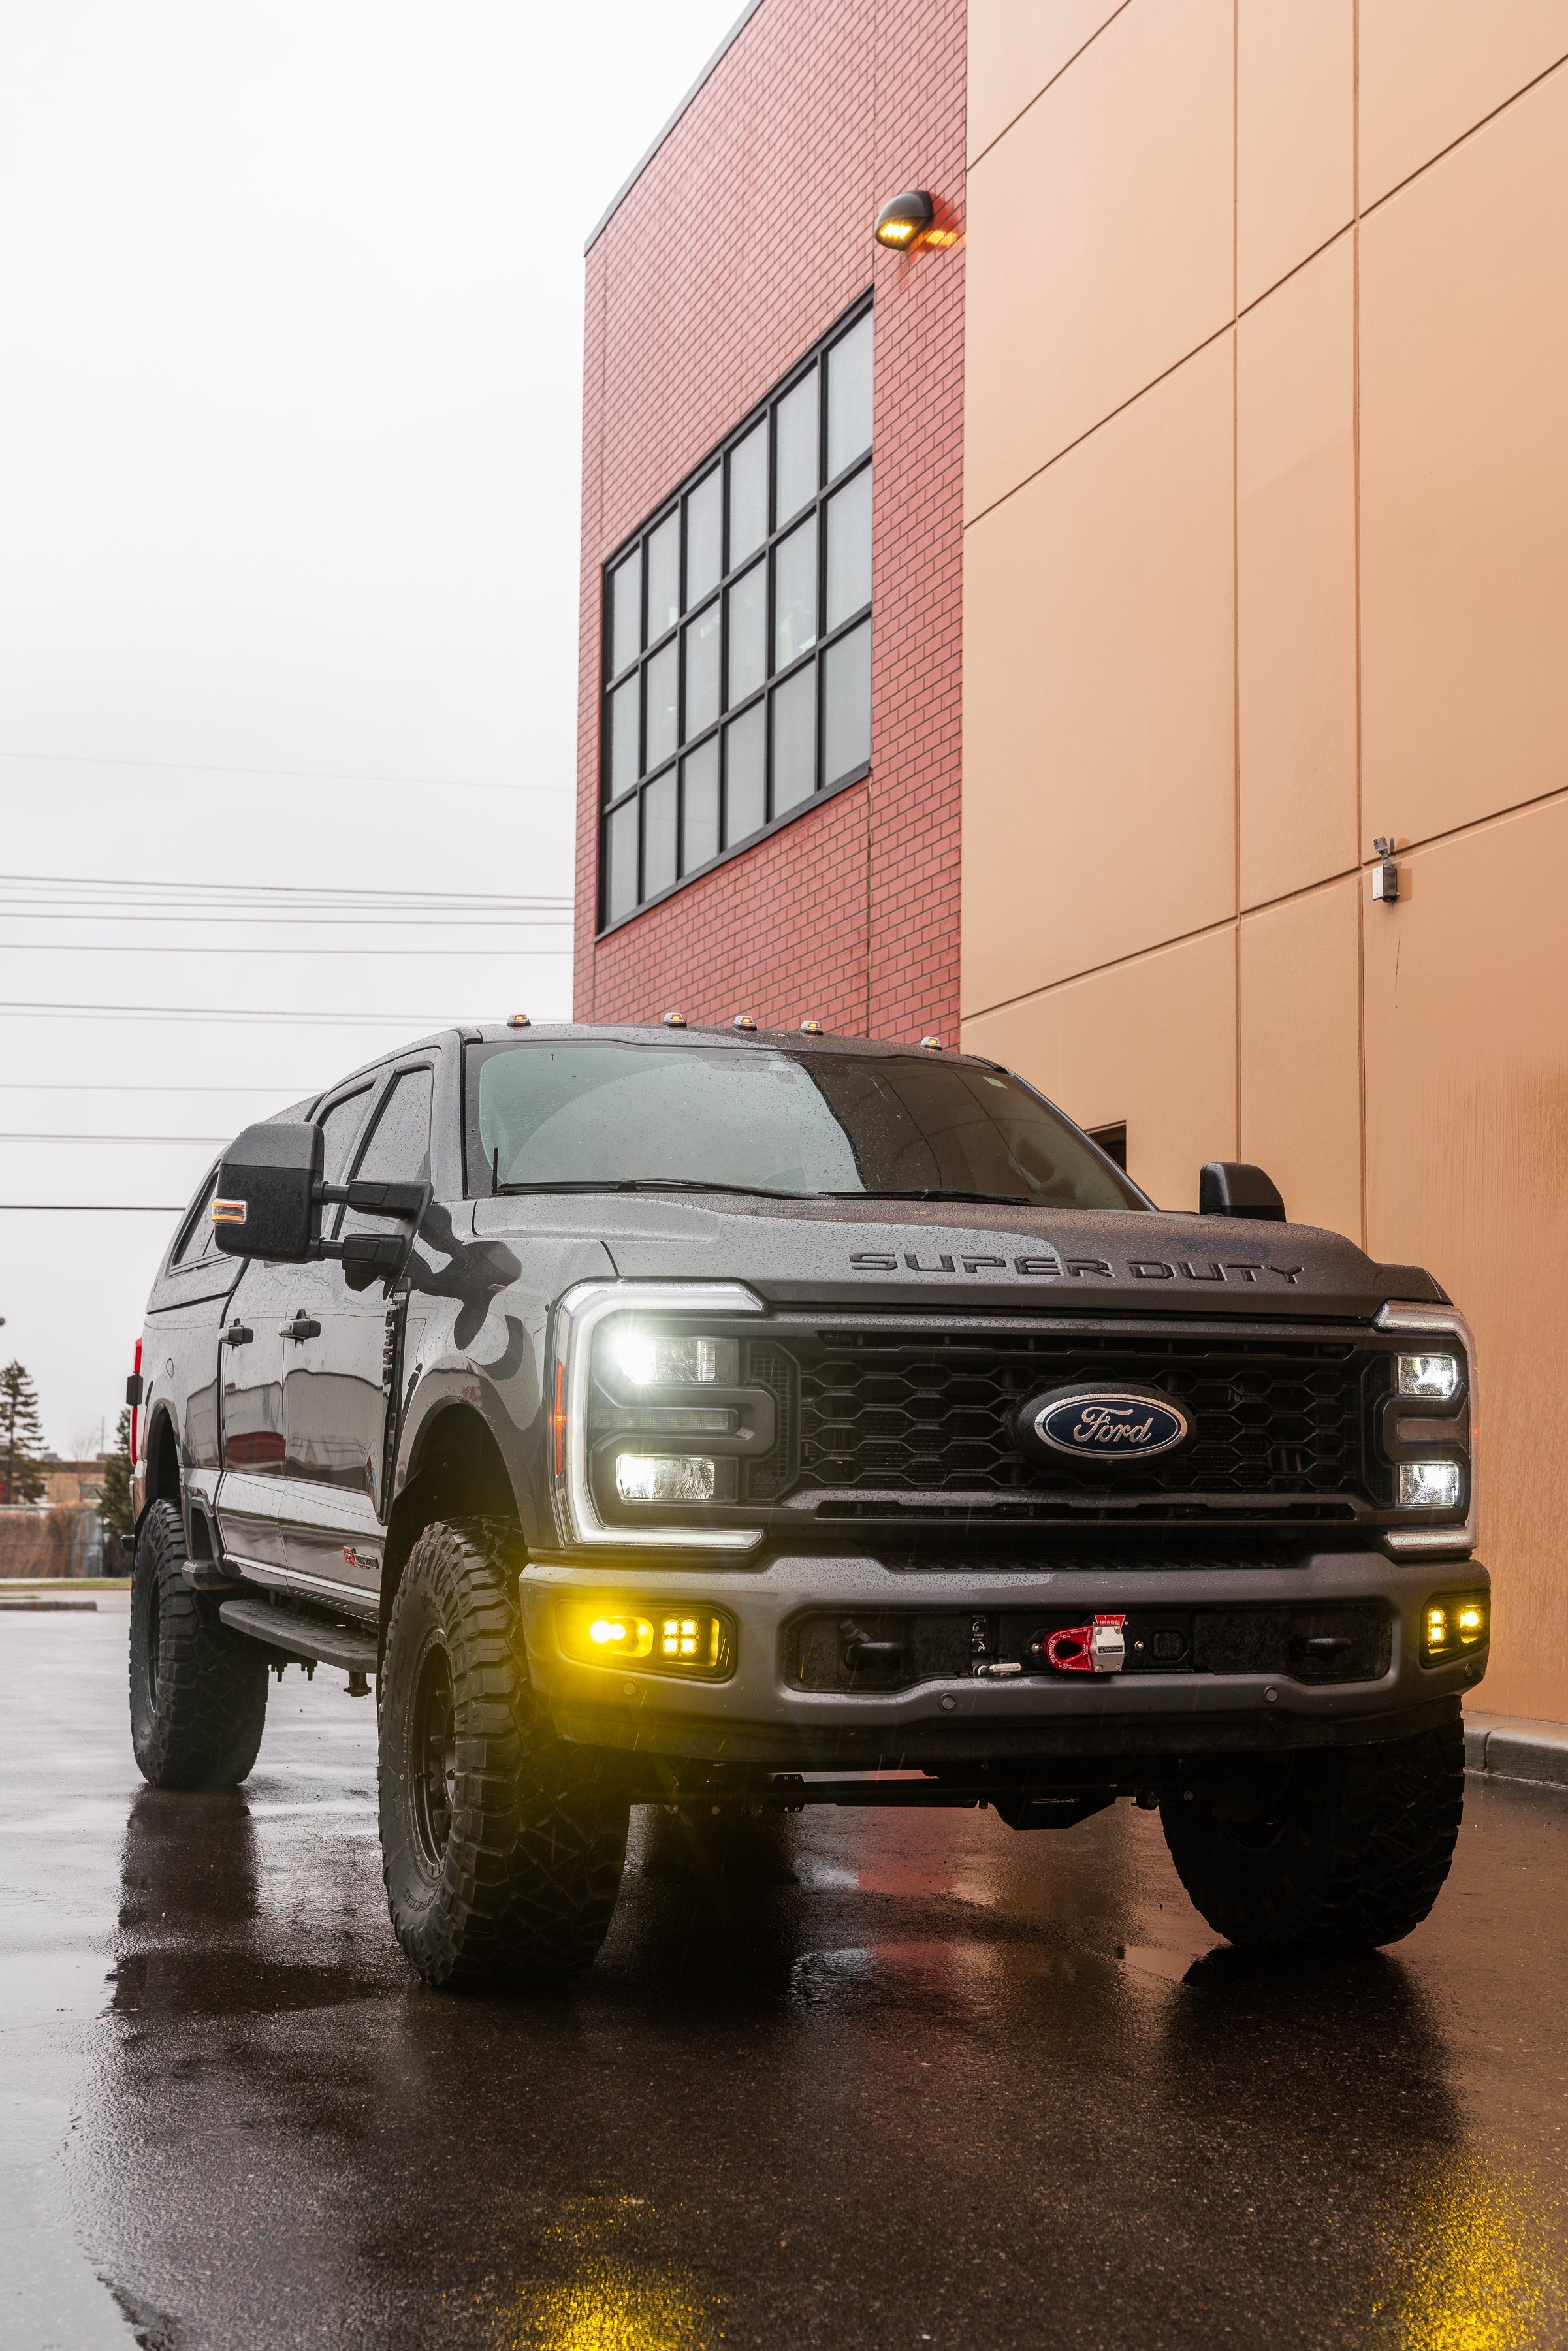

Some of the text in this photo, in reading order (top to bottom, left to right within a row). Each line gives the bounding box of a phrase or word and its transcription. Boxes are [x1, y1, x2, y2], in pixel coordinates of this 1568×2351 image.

[849, 1253, 1305, 1284] SUPER DUTY
[1073, 1407, 1154, 1443] Ford
